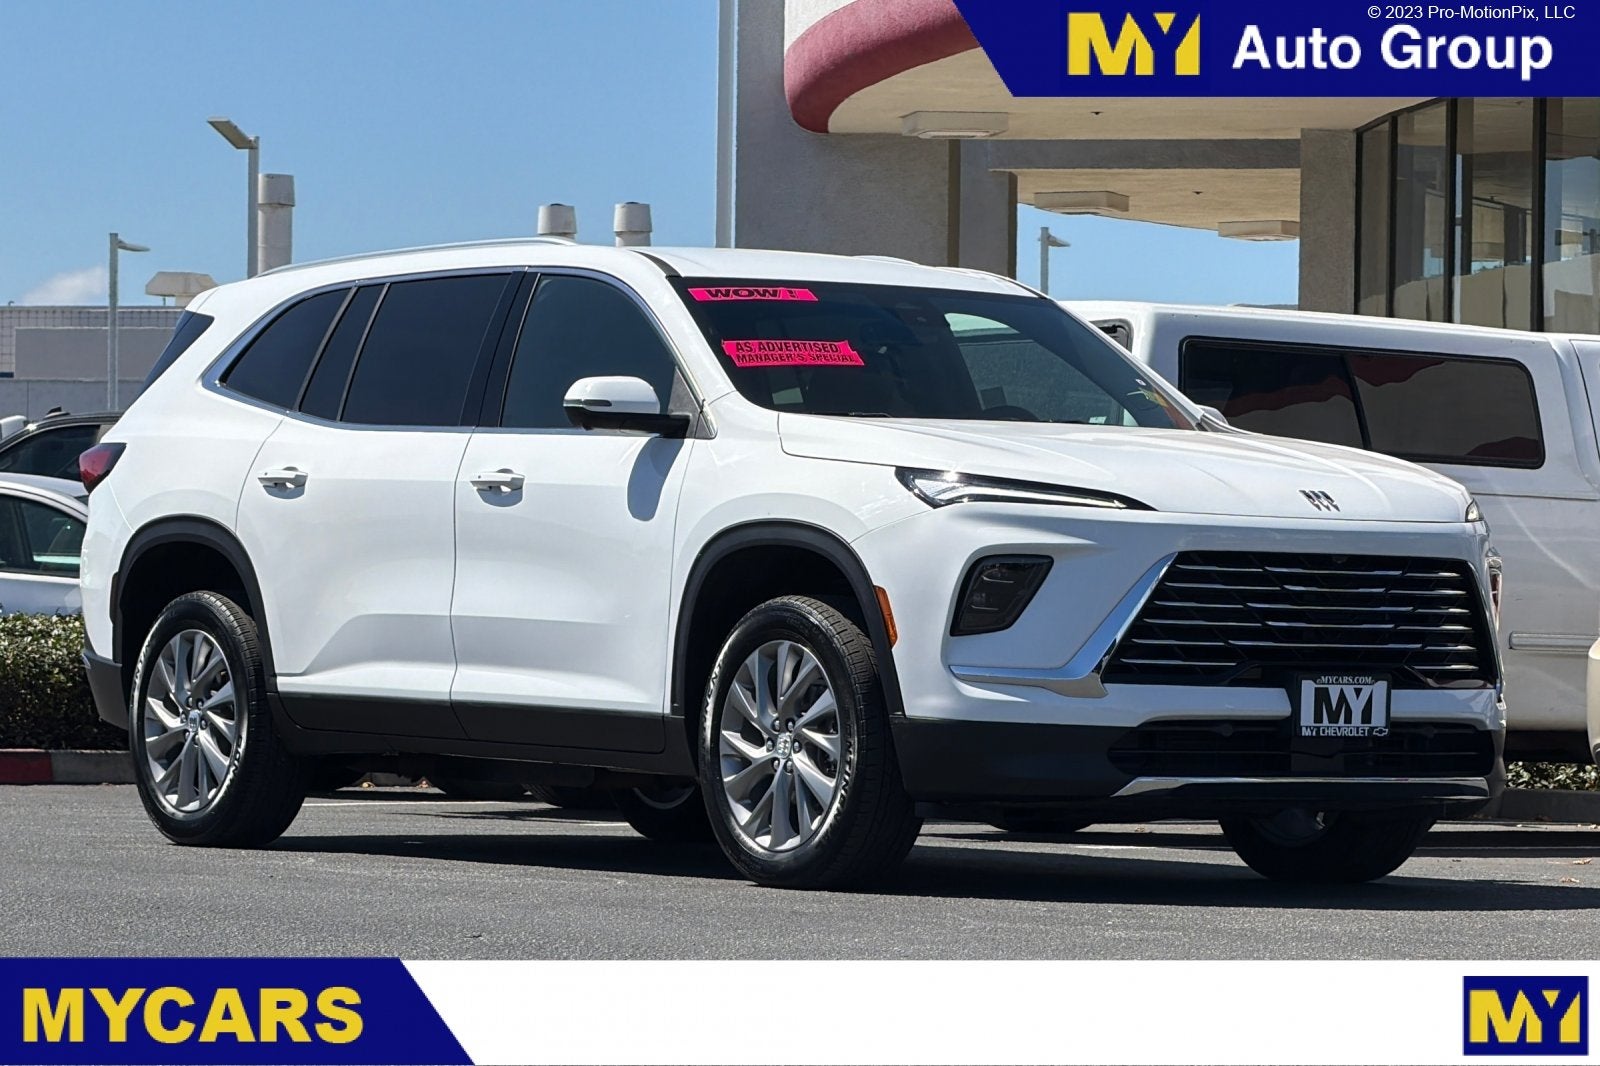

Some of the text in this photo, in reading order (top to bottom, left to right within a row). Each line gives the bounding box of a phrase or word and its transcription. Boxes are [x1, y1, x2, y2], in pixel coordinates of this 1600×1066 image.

[735, 341, 839, 354] AS ADVERTISED
[736, 352, 855, 363] MANAGER'S SPECIAL
[1313, 686, 1374, 725] MY
[1302, 727, 1370, 737] MY CHEVROLET
